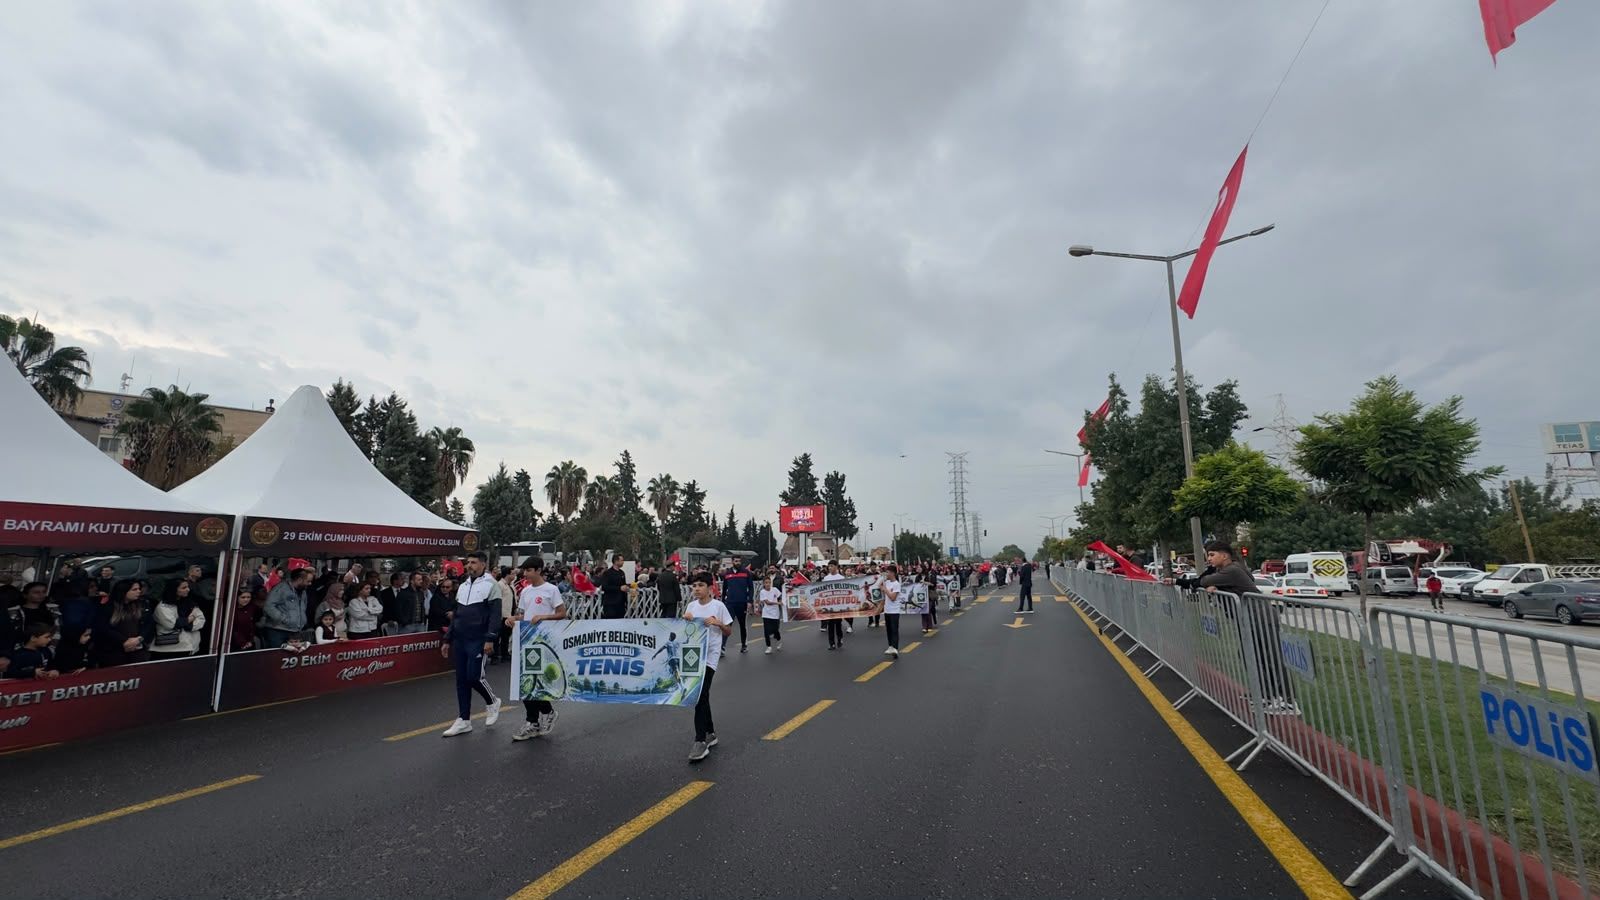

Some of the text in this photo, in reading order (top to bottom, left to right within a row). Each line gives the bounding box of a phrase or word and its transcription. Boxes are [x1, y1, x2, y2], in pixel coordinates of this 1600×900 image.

[3, 519, 189, 536] BAYRAMI KUTLU OLSUN
[283, 531, 461, 547] 29 EKİM CUMHURİYET BAYRAMI KUTLU OLSUN
[814, 595, 861, 607] BASKETBOL
[563, 630, 656, 650] OSMANİYE BELEDİYESİ
[281, 640, 440, 669] 29 EKİM CUMHURİYET BAYRAMI
[583, 647, 603, 656] SPOR
[337, 660, 395, 681] Kutlu Olsun
[576, 658, 645, 676] TENİS
[51, 678, 140, 701] BAYRAMI
